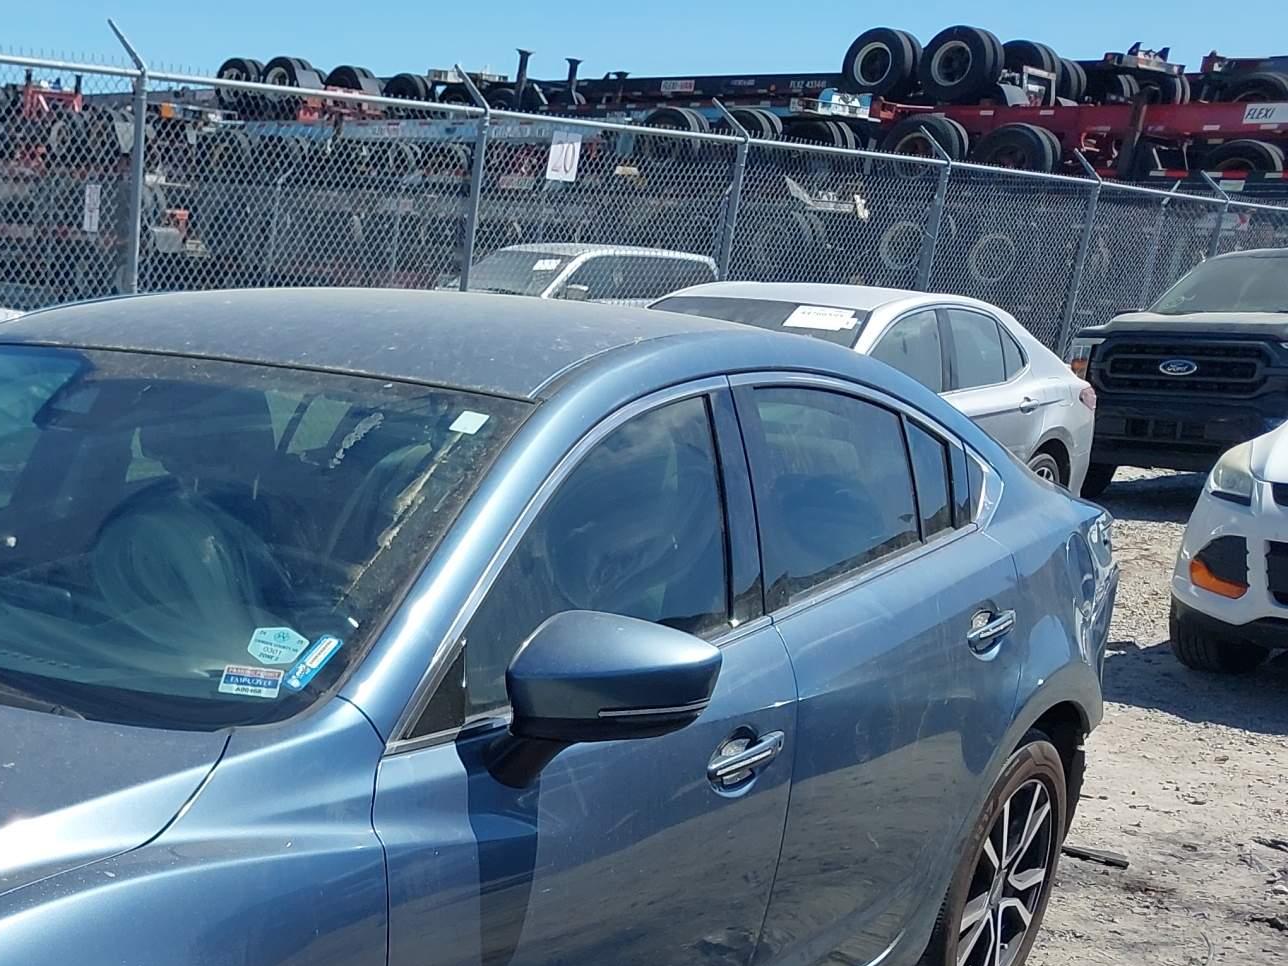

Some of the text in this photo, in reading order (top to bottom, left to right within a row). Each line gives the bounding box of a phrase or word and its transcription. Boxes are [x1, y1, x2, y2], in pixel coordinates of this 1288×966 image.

[1245, 107, 1276, 120] FLEXI
[550, 140, 576, 174] 20
[1165, 363, 1189, 372] Ford
[230, 675, 273, 686] EMPLOYEE
